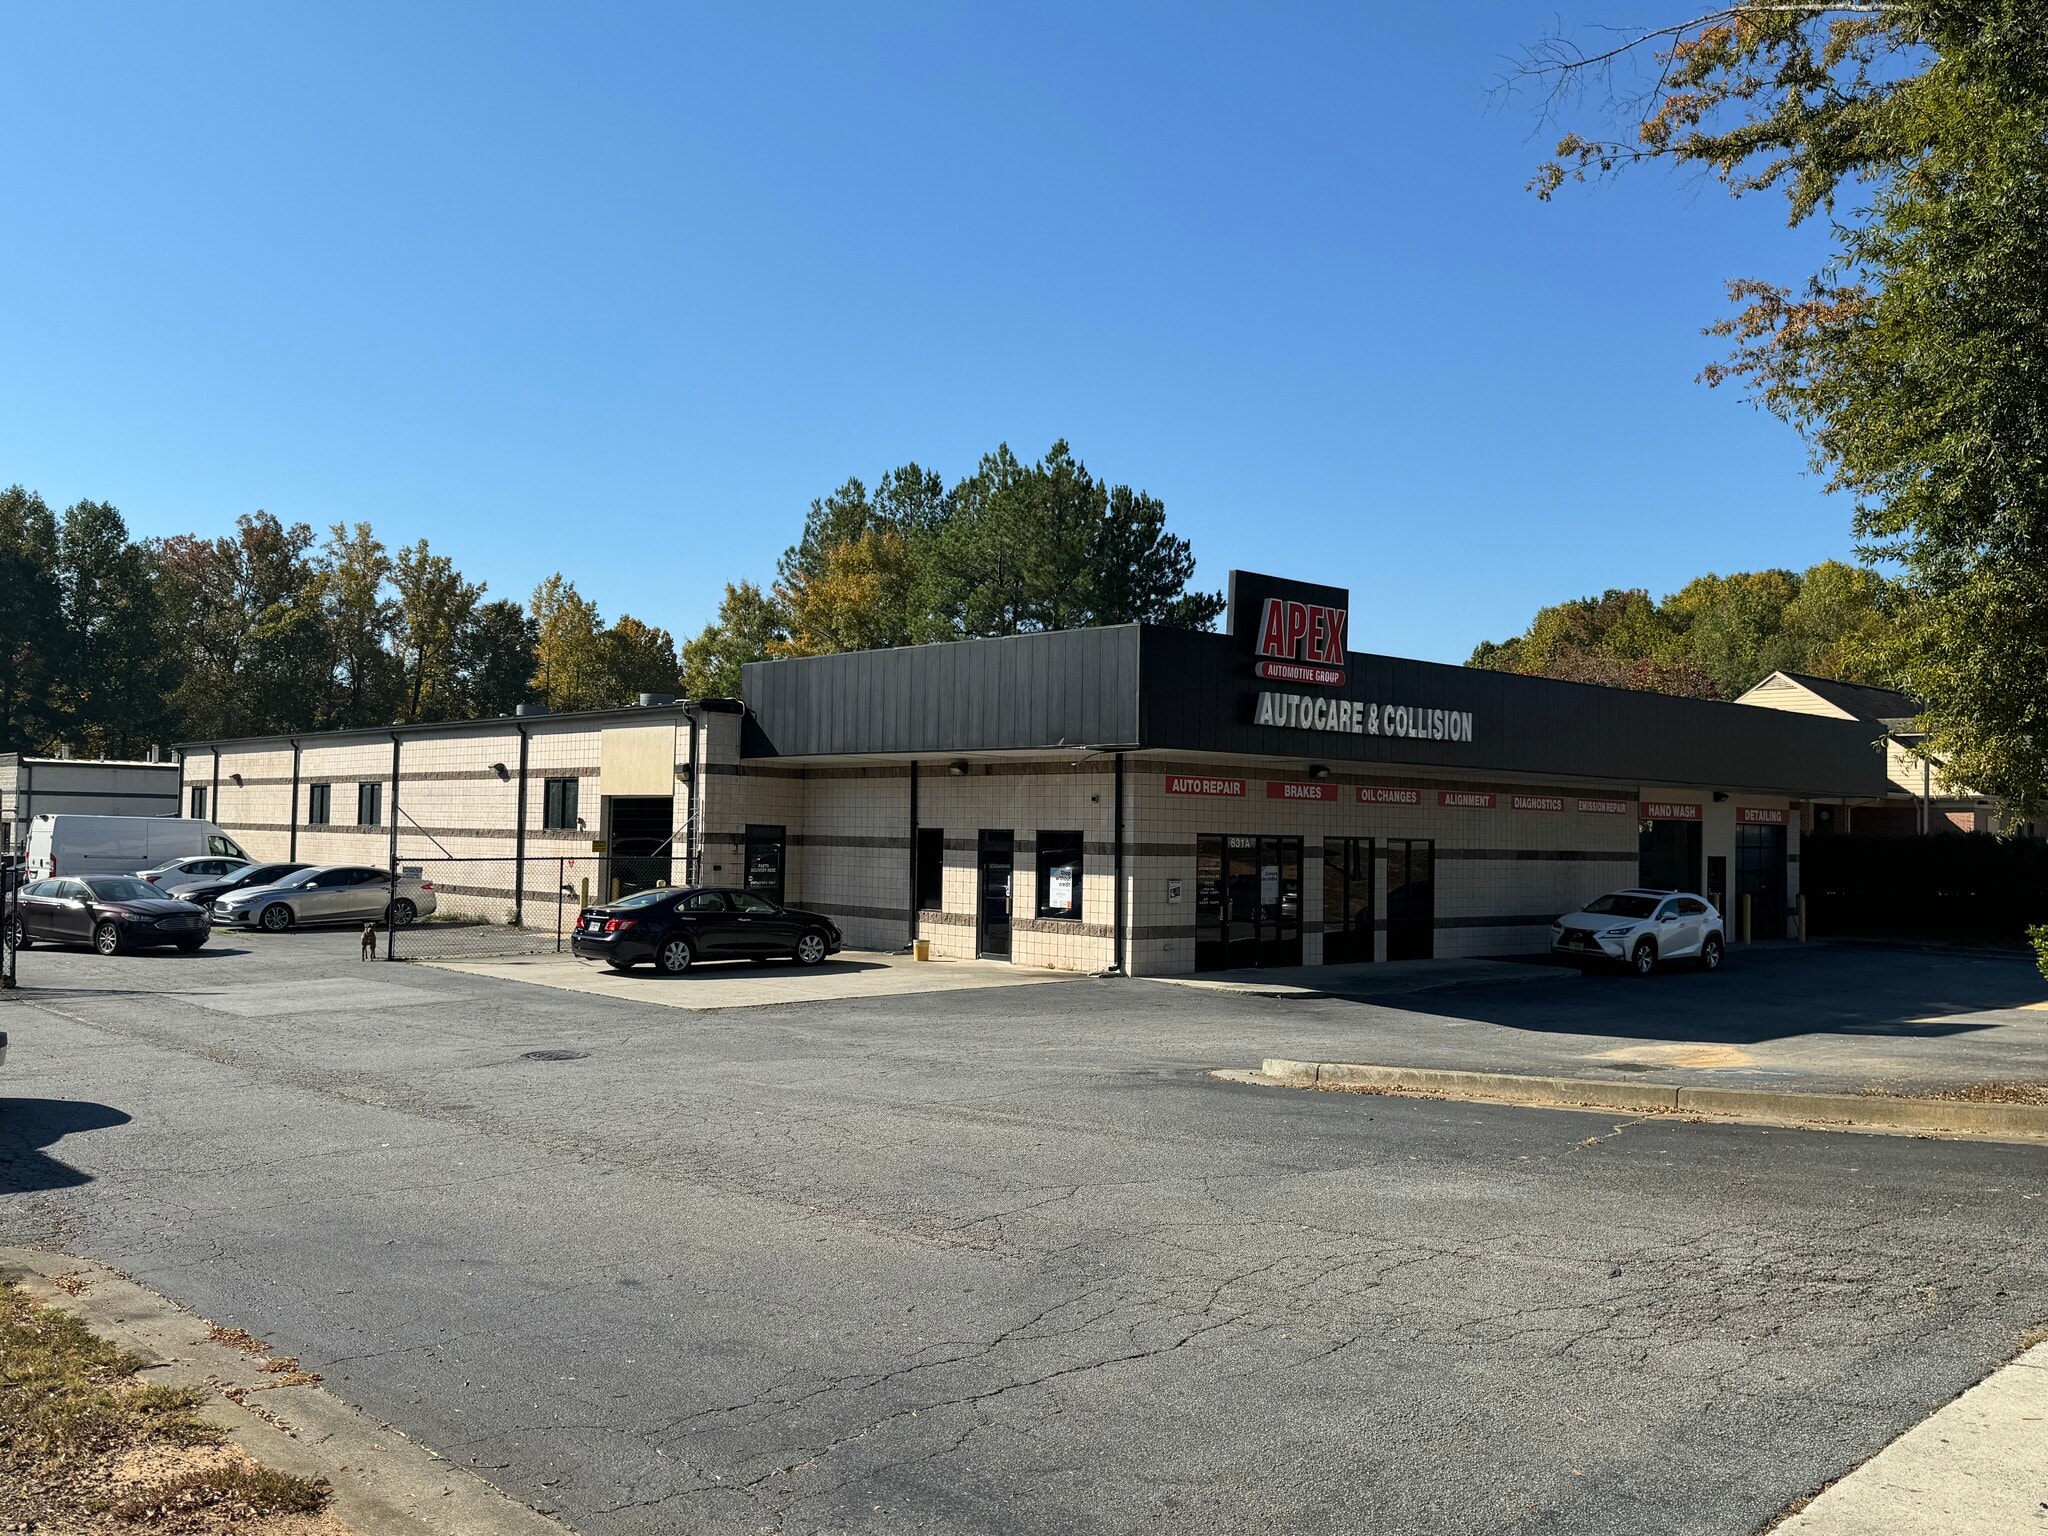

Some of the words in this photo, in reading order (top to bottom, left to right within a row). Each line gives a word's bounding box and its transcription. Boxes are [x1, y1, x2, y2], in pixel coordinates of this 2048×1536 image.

[1256, 598, 1346, 665] APEX
[1267, 665, 1314, 681] AUTOMOTIVE
[1315, 670, 1340, 684] GROUP
[1254, 691, 1364, 734] AUTOCARE
[1368, 702, 1379, 735] &
[1381, 704, 1473, 743] COLLISION
[1172, 779, 1201, 793] AUTO
[1203, 780, 1241, 795] REPAIR
[1284, 785, 1322, 799] BRAKES
[1361, 789, 1376, 801] OIL
[1377, 790, 1417, 803] CHANGES
[1445, 794, 1490, 807] ALIGNMENT
[1514, 797, 1562, 811] DIAGNOSTICS
[1578, 800, 1605, 812] EMISSION
[1606, 803, 1626, 813] REPAIR
[1649, 804, 1671, 817] HAND
[1672, 805, 1696, 818] WASH
[1744, 809, 1782, 823] DETAILING
[1231, 838, 1250, 848] 631A
